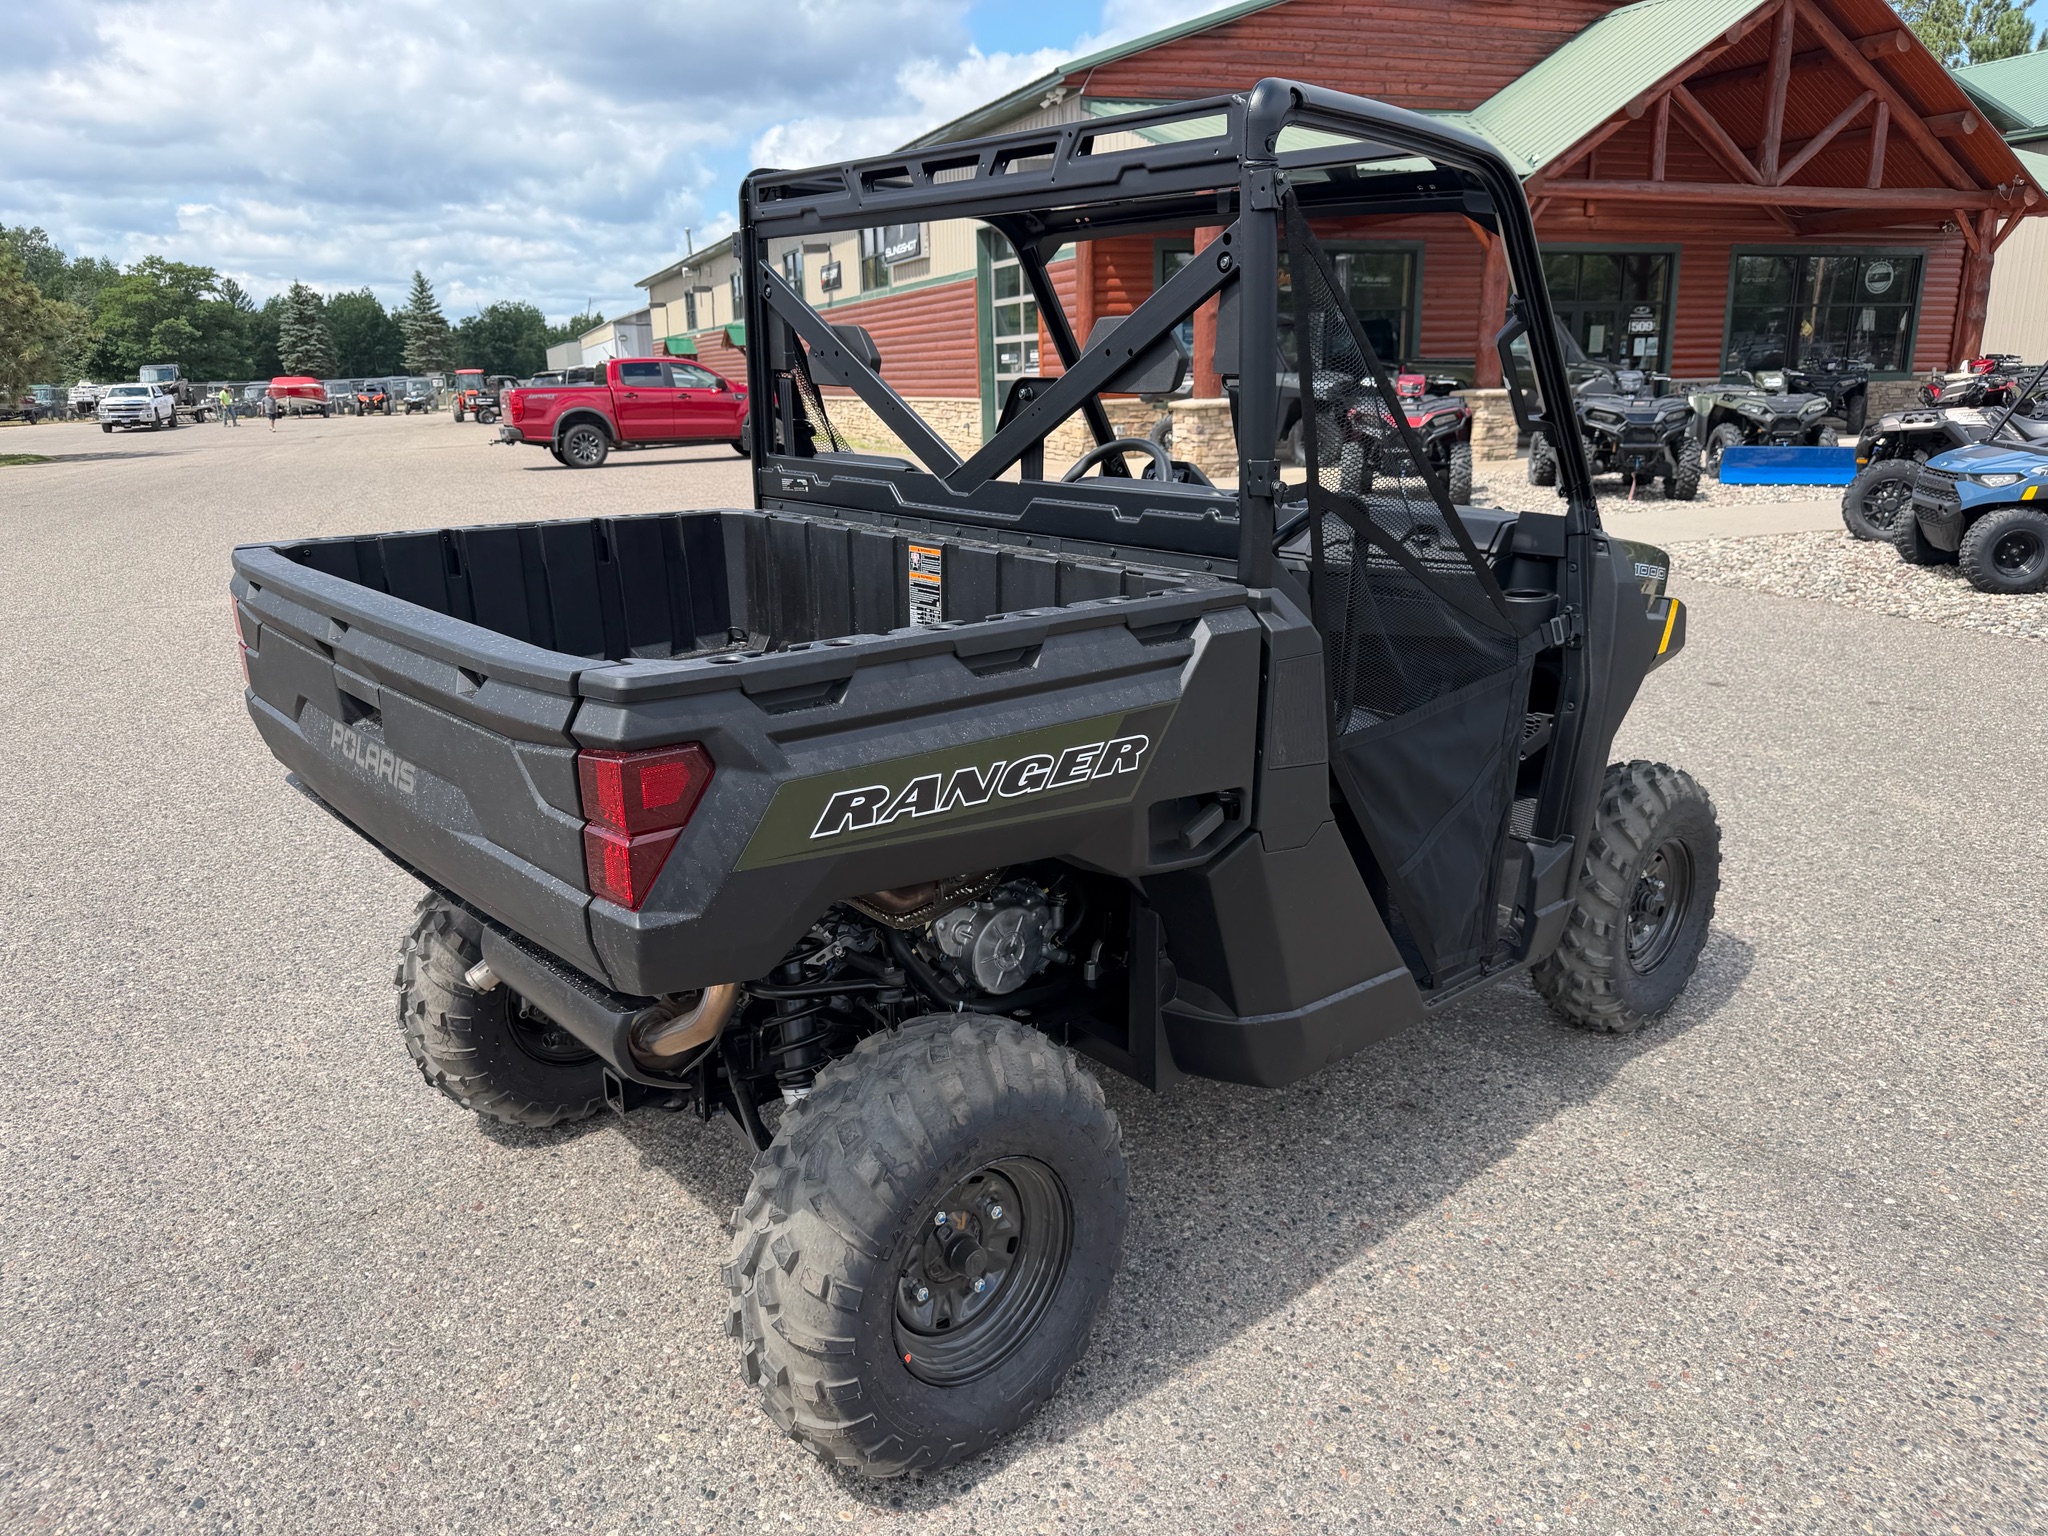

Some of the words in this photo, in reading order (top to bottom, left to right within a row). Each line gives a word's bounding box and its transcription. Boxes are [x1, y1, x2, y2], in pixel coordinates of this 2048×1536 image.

[1634, 562, 1666, 581] 1000
[331, 720, 416, 795] POLARIS
[810, 734, 1149, 838] RANGER
